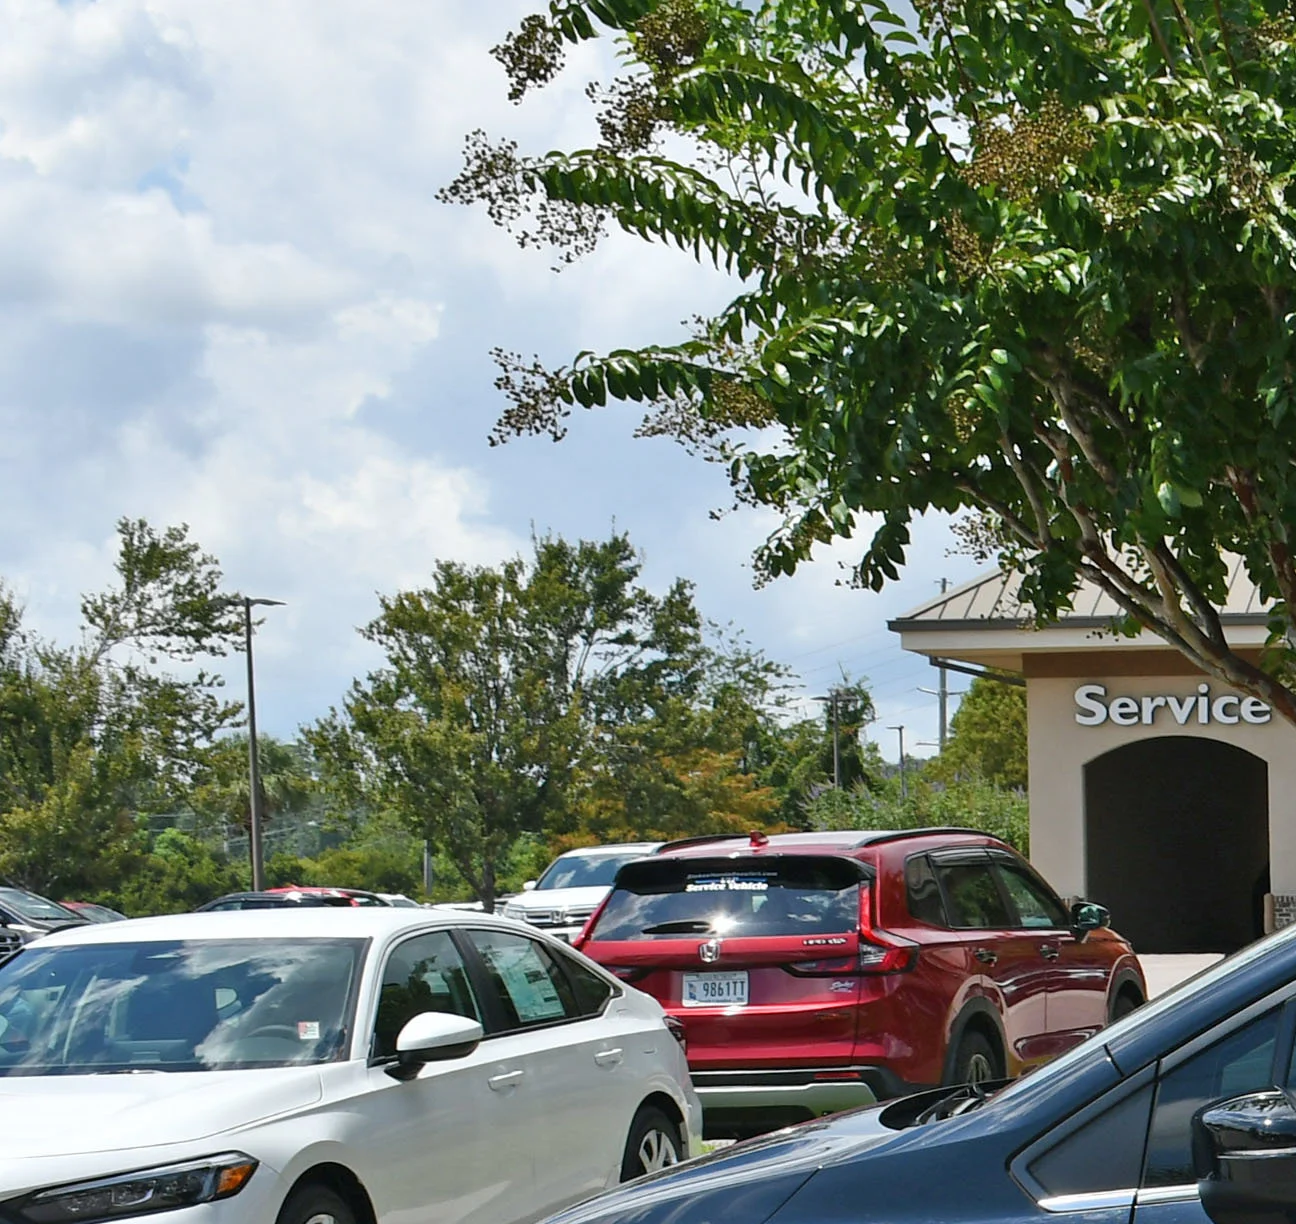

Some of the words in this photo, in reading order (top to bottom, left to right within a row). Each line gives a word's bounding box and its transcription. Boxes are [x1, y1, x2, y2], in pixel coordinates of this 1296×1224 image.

[1074, 683, 1272, 725] Service
[685, 883, 726, 892] Service
[728, 881, 768, 891] Vehicle
